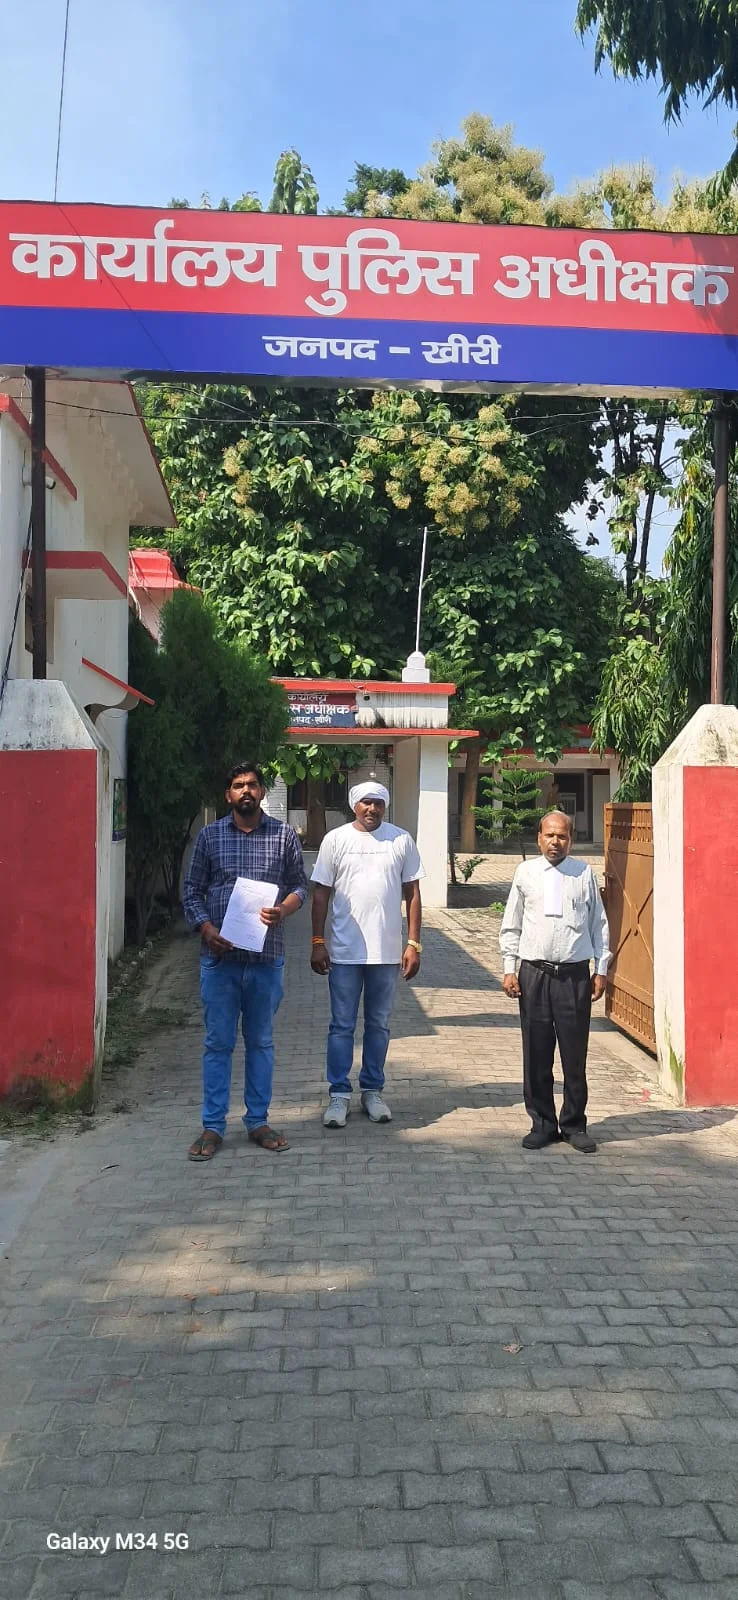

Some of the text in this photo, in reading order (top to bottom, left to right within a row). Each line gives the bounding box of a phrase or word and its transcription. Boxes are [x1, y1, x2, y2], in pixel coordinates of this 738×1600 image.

[8, 218, 735, 316] कार्यालय पुलिस अधीक्षक
[261, 335, 380, 361] जनपद
[420, 333, 502, 366] खीरी
